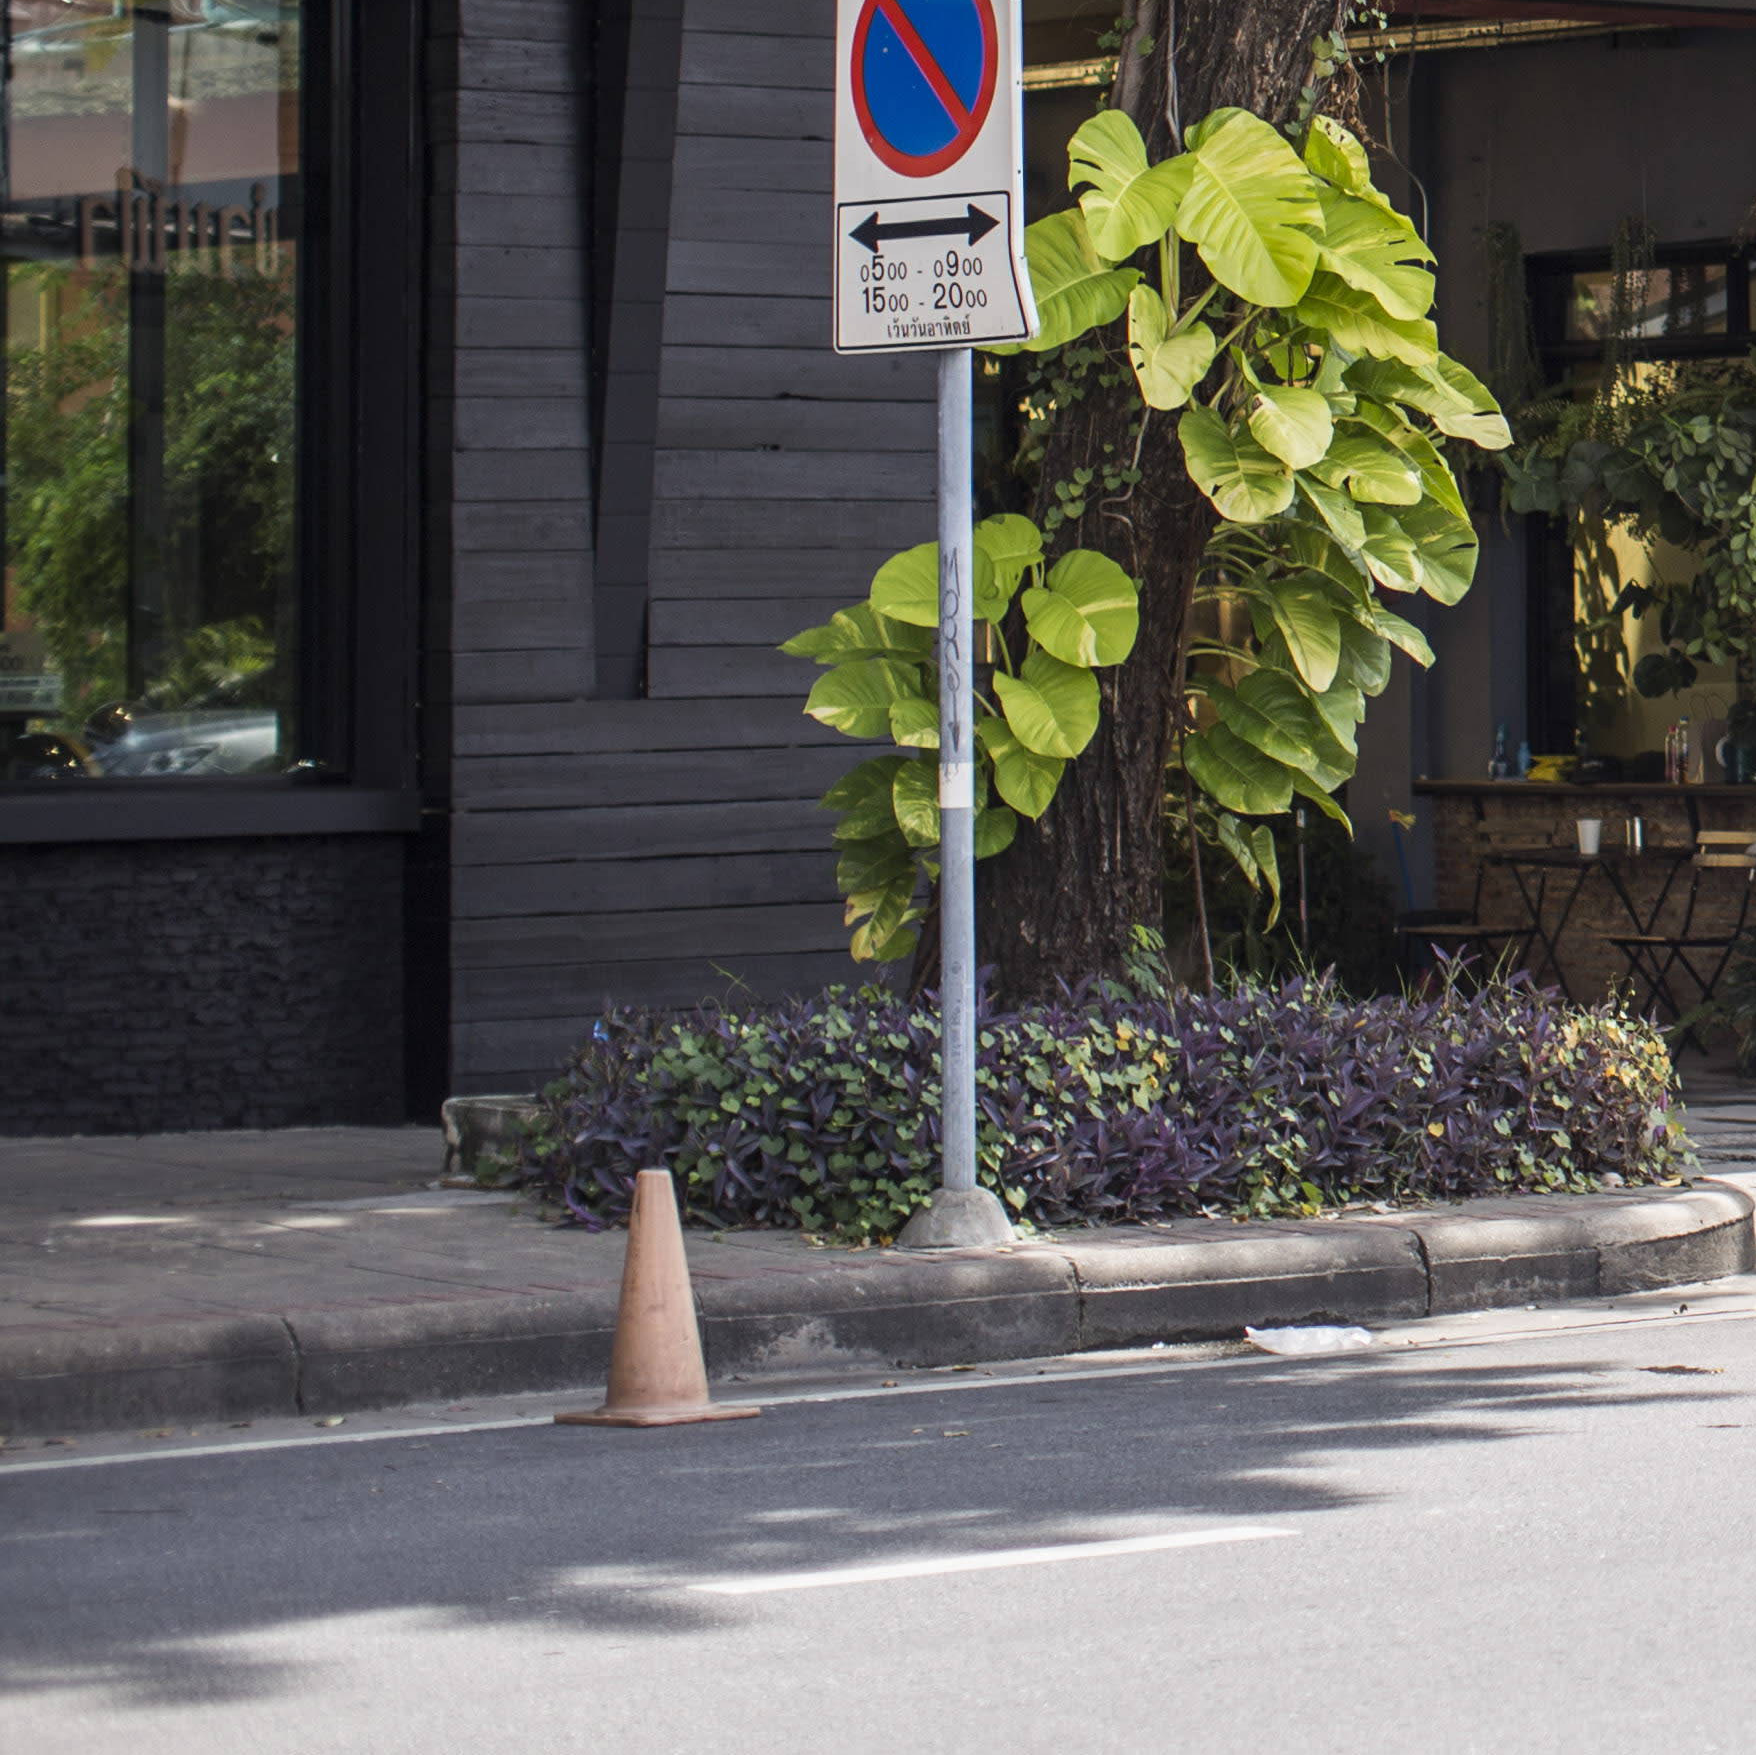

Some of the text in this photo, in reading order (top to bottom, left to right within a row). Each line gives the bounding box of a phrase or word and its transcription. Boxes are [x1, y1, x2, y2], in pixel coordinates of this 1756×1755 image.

[862, 287, 909, 314] 1500
[933, 282, 987, 309] 2000
[887, 314, 971, 338] เว้นวันอาทิตย์
